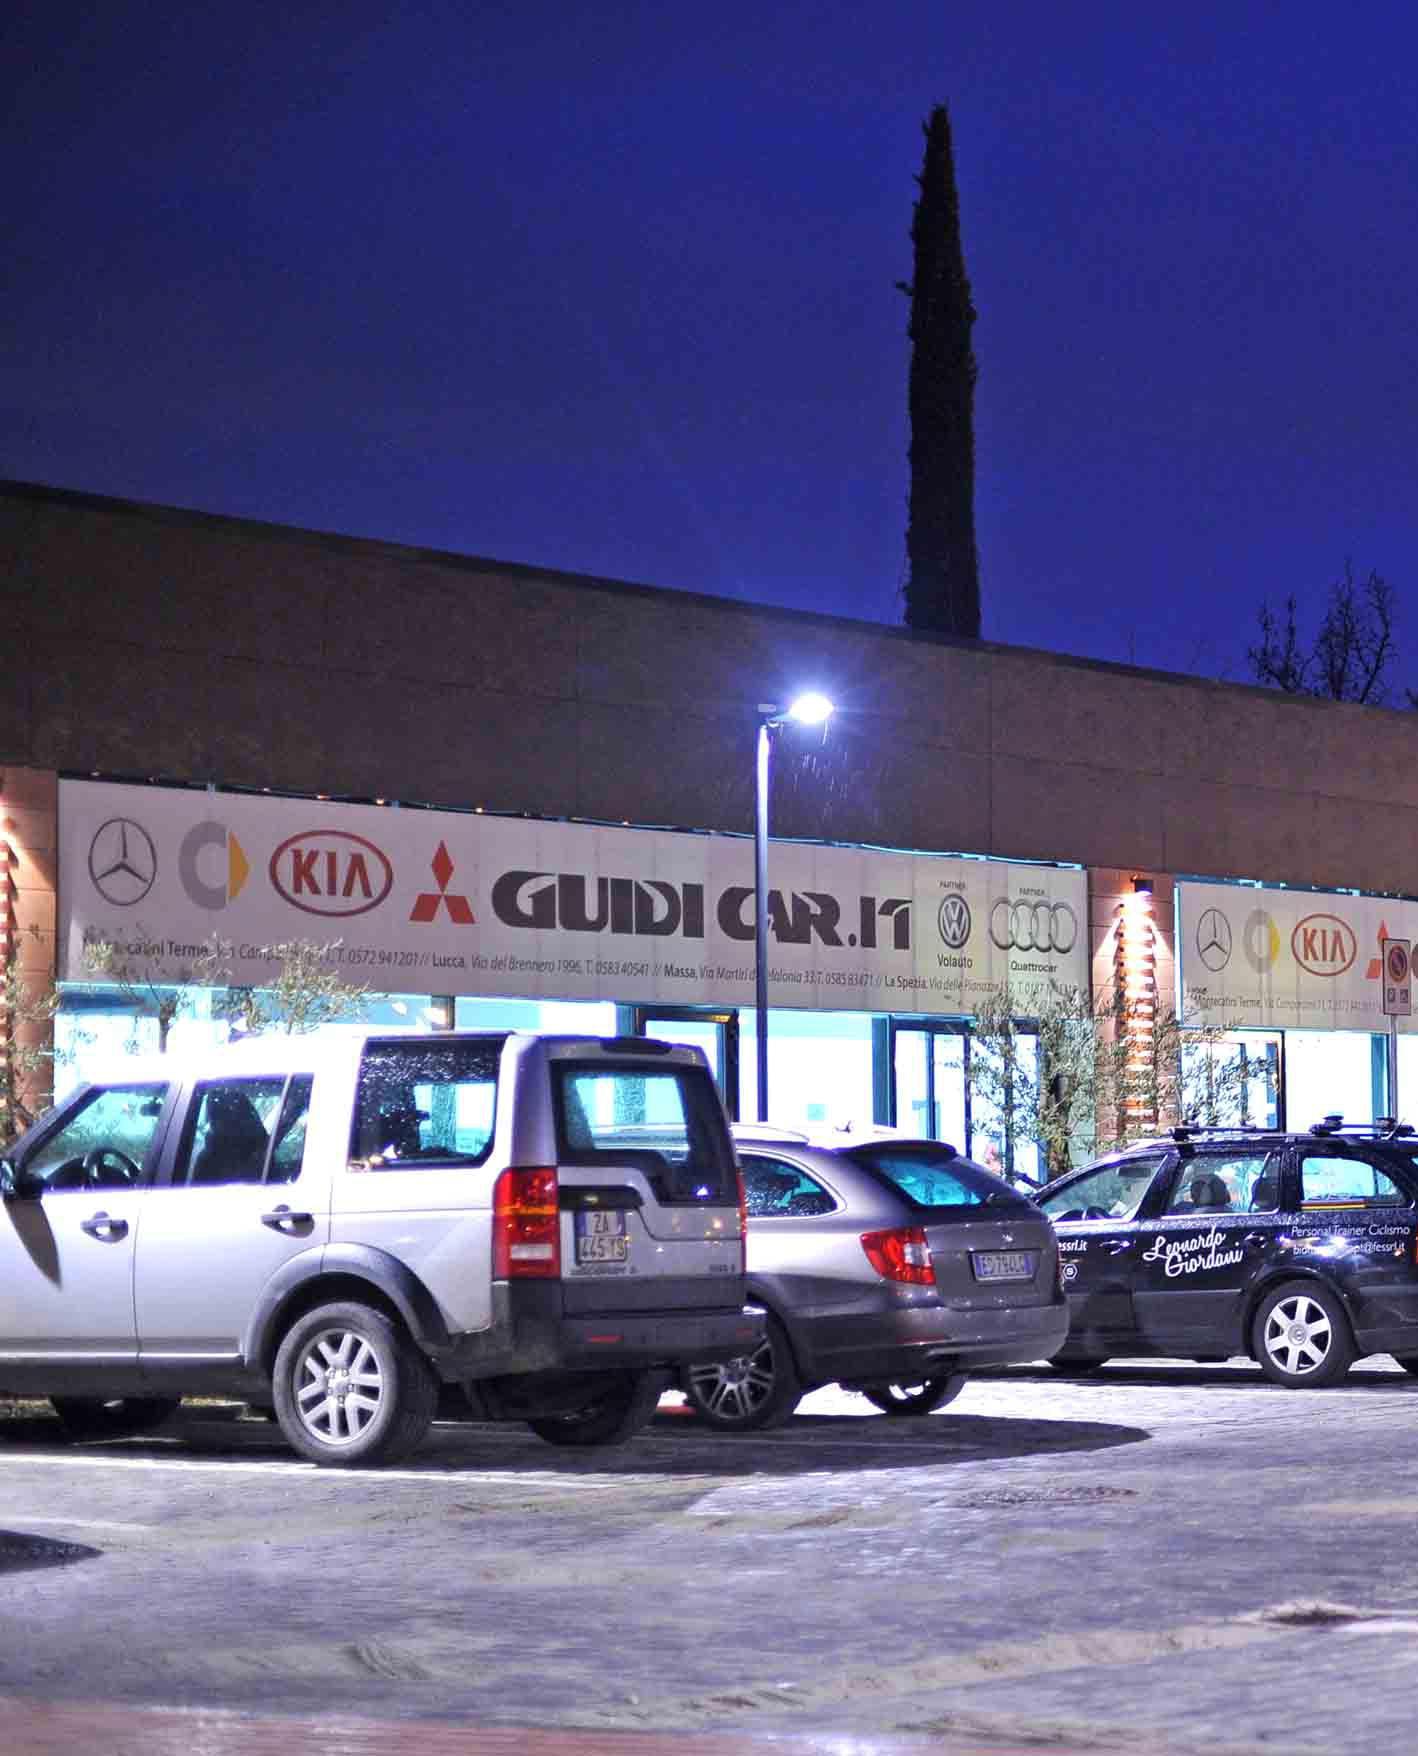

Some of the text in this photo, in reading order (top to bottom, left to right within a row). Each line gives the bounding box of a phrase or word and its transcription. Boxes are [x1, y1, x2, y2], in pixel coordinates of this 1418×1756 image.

[292, 848, 373, 898] KIA
[491, 870, 913, 951] GUIDI CAR.IT
[937, 953, 973, 969] Volauto
[1303, 927, 1345, 962] KIA
[1010, 960, 1057, 973] Quattrocar
[1291, 1222, 1411, 1238] Personal Trainer Ciclismo
[1143, 1223, 1244, 1278] Leonardo Giordani
